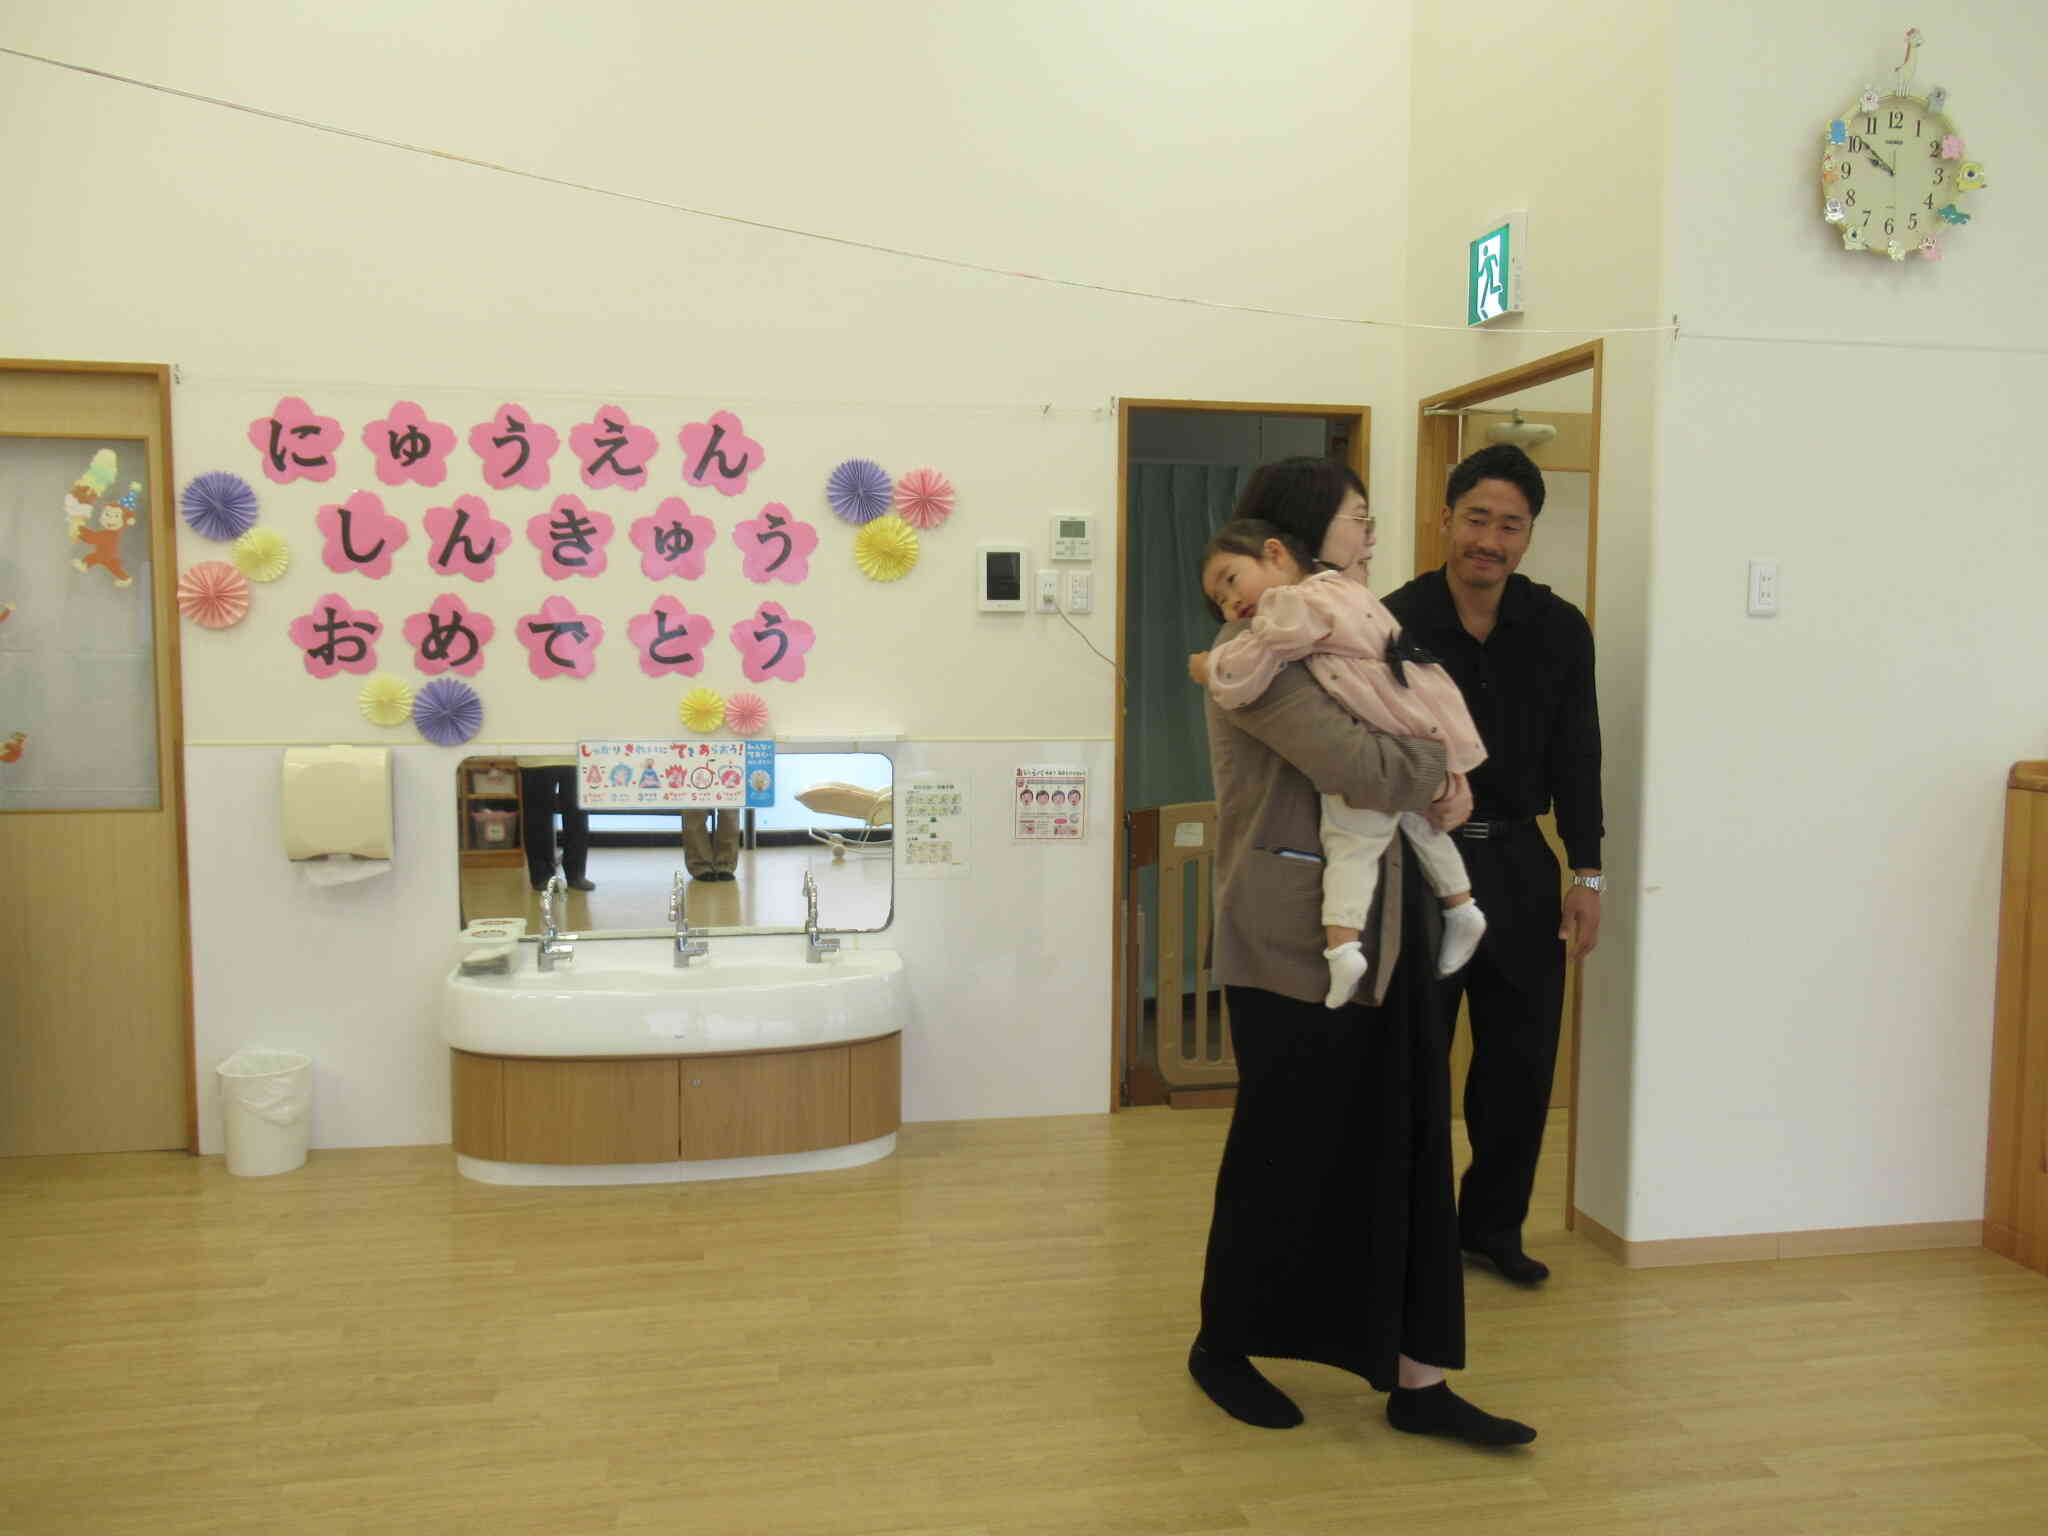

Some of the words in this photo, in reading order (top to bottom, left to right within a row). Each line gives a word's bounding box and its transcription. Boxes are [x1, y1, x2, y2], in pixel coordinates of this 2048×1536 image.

[1865, 117, 1877, 134] 11
[1888, 111, 1904, 129] 12
[1915, 119, 1921, 137] 1
[1848, 136, 1862, 153] 10
[1929, 141, 1940, 158] 2
[1841, 161, 1852, 180] 9
[1933, 168, 1943, 185] 3
[1845, 189, 1856, 206] 8
[1923, 193, 1934, 209] 4
[1862, 210, 1871, 227] 7
[1884, 217, 1894, 235] 6
[1908, 212, 1918, 230] 5
[269, 418, 749, 480] にゅうえん
[337, 507, 794, 573] しんきゅう
[306, 607, 792, 671] おめでとう
